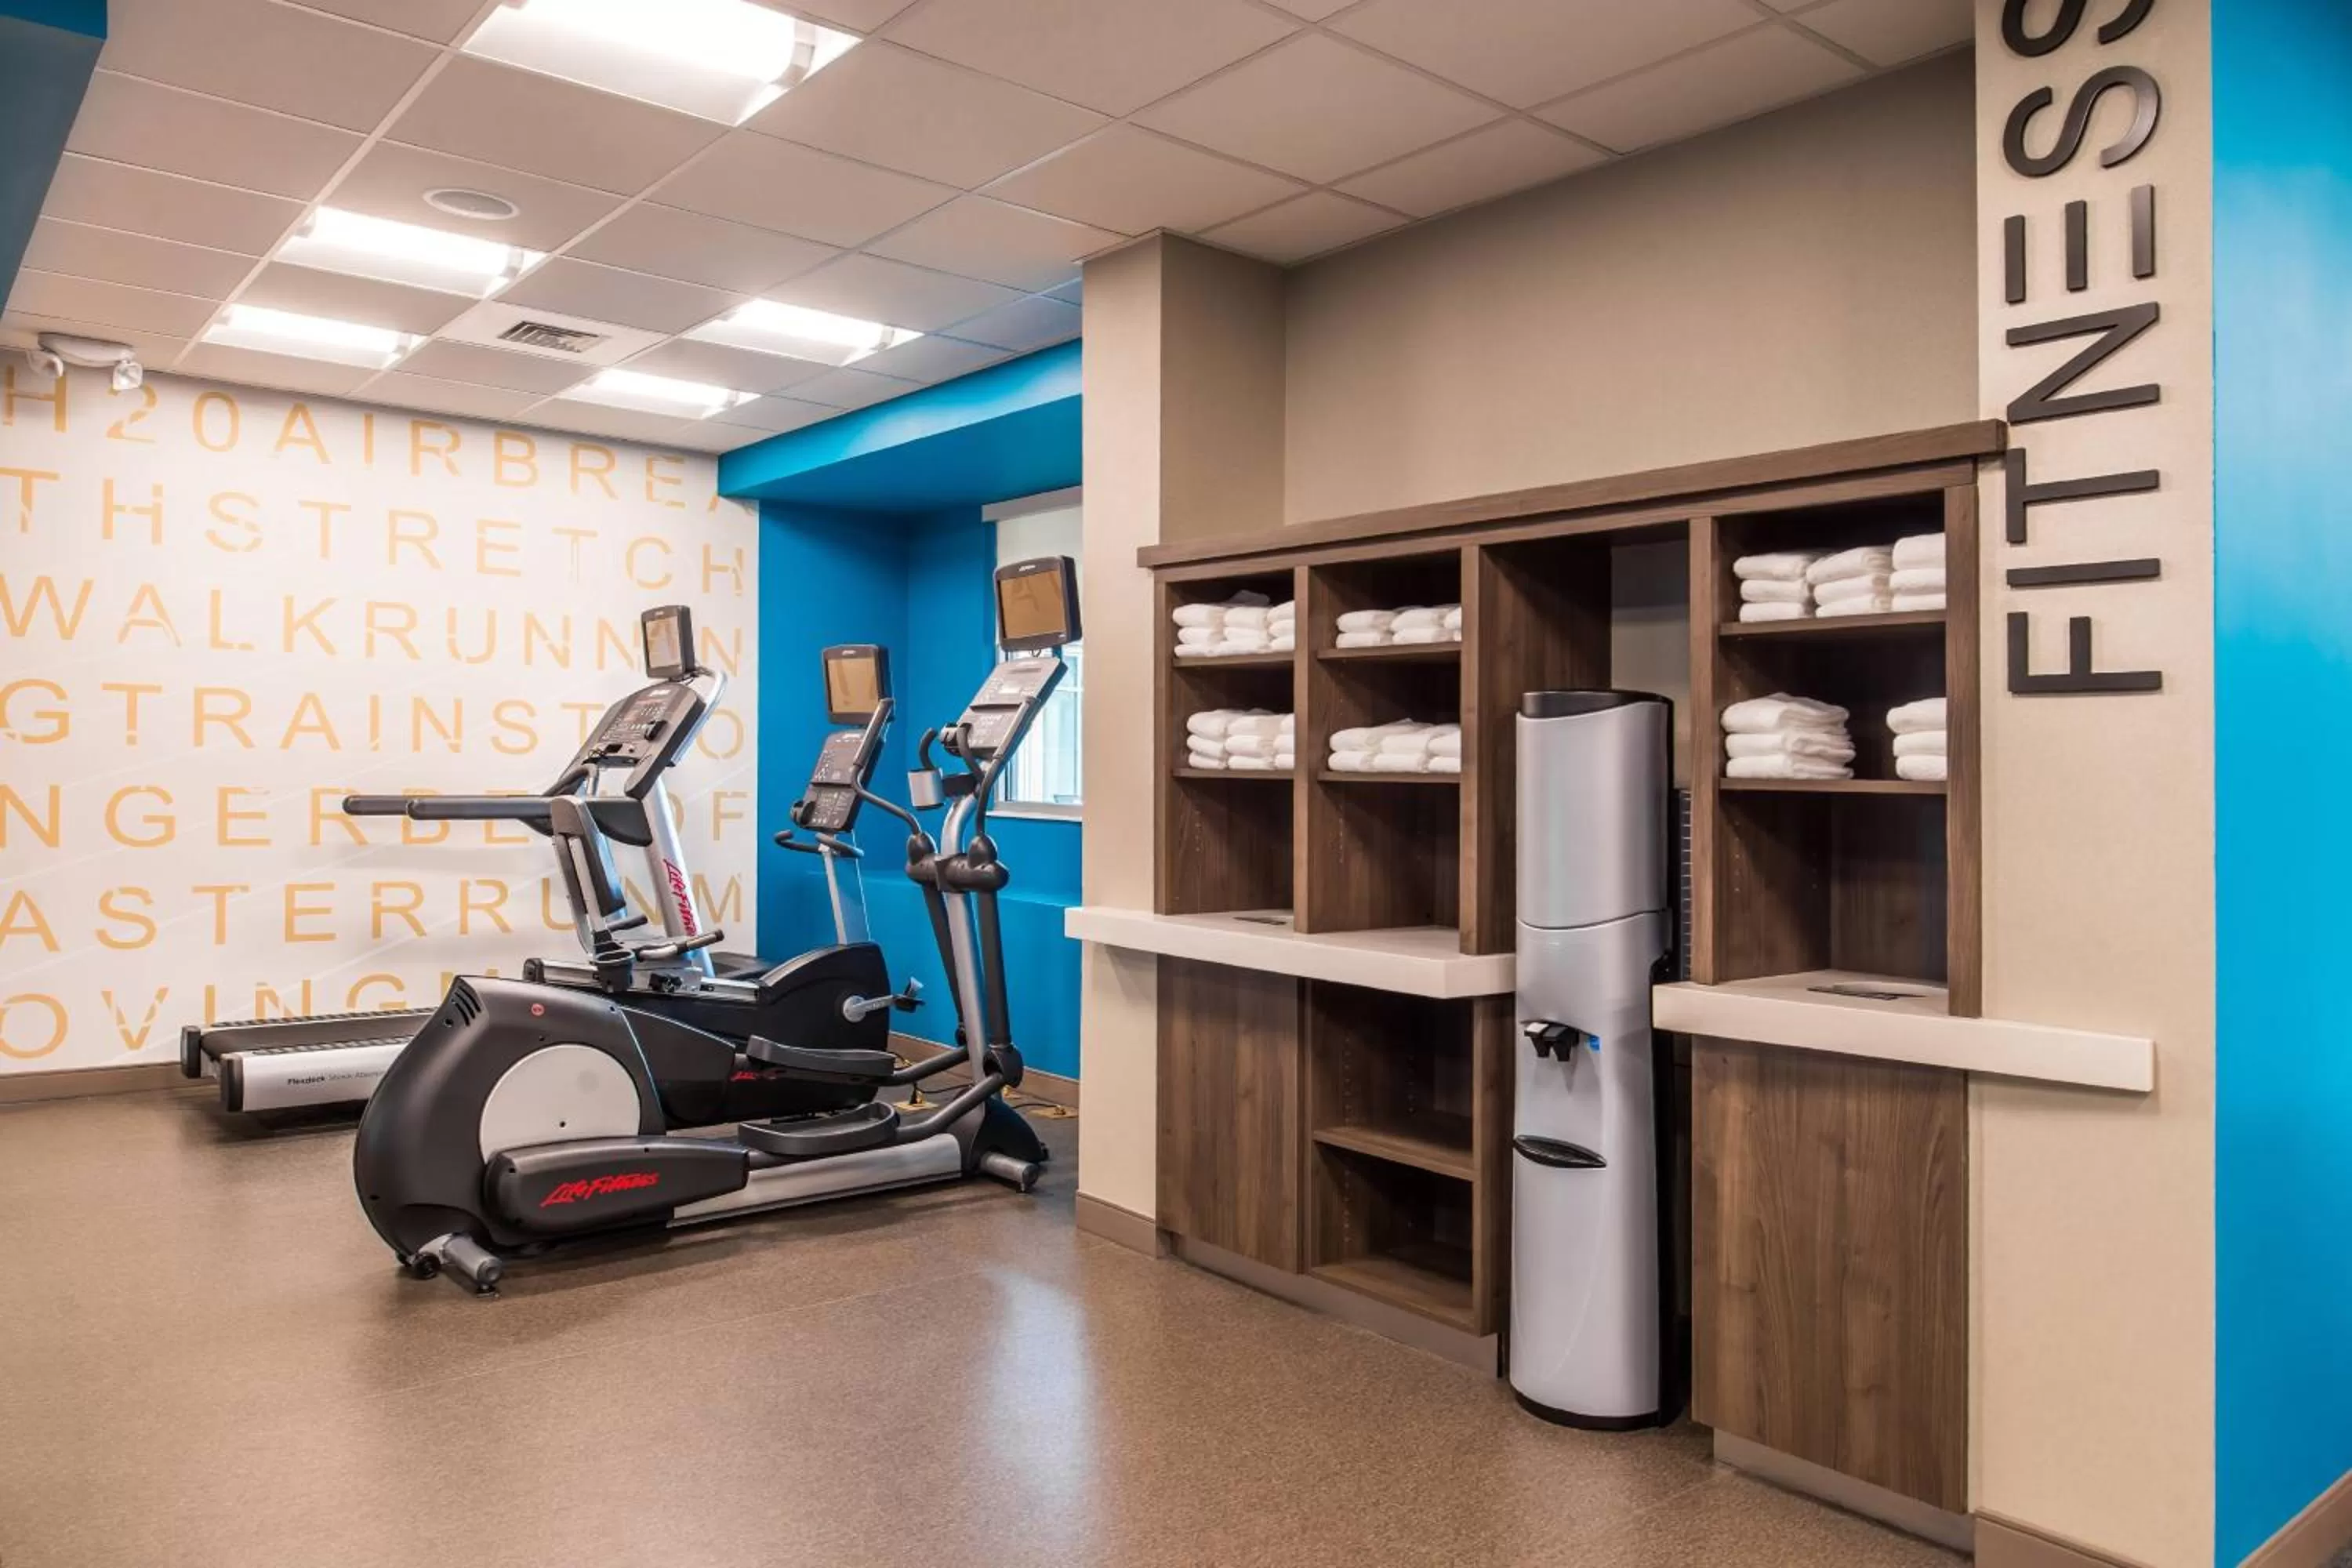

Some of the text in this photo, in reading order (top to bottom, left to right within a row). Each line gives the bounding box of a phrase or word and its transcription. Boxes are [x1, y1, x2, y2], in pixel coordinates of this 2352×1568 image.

[2002, 0, 2161, 695] FITNESS
[0, 573, 742, 677] WALKRUNNN
[2, 678, 744, 759] GTRAINSTO
[539, 1180, 588, 1207] Life
